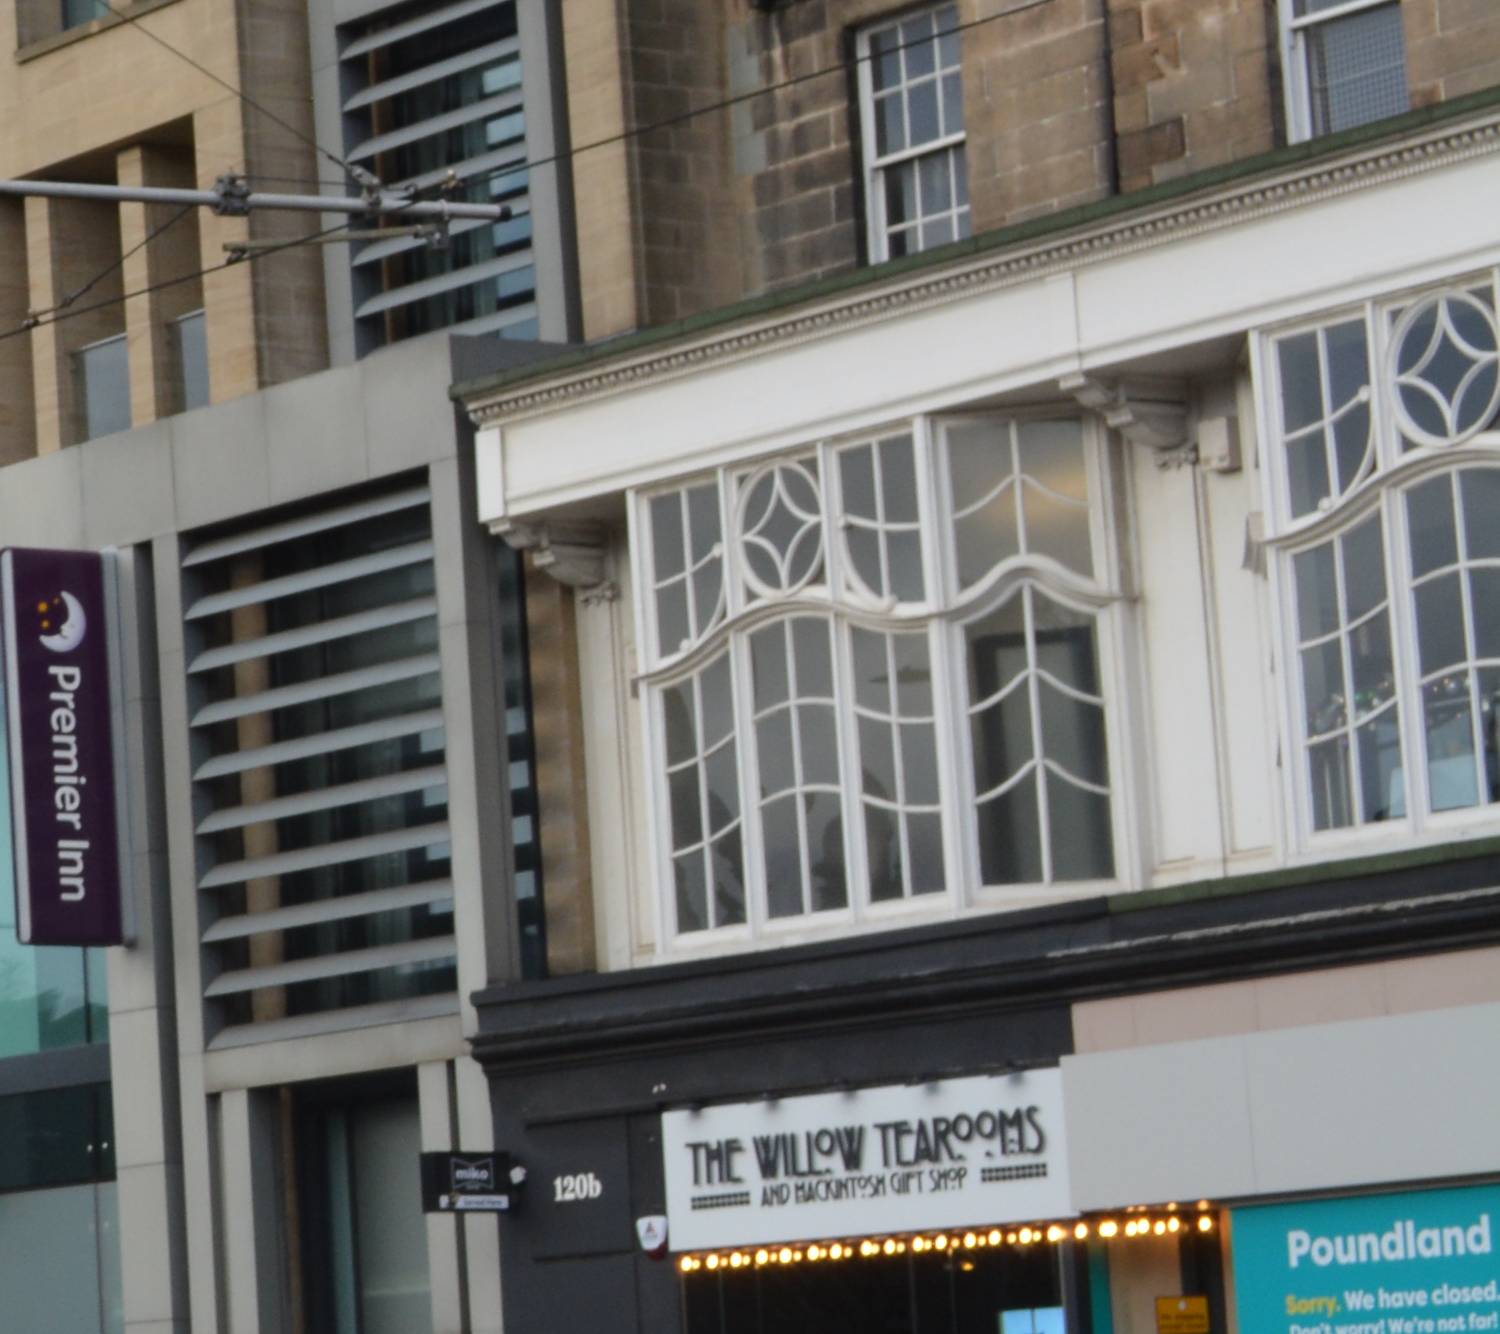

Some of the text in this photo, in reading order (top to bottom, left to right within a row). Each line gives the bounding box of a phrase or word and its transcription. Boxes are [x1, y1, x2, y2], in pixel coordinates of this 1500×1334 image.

[48, 666, 90, 901] Premier Inn
[686, 1105, 1047, 1184] THE WILLOW TEAROOMS
[553, 1172, 602, 1202] 120b
[760, 1167, 967, 1207] AND MACKINTOSH GIFT SHOP
[1287, 1214, 1491, 1268] Poundland
[1286, 1279, 1500, 1317] Sorry. We have closed.
[1388, 1316, 1434, 1334] We're
[1437, 1314, 1466, 1332] not
[1468, 1311, 1498, 1330] far!
